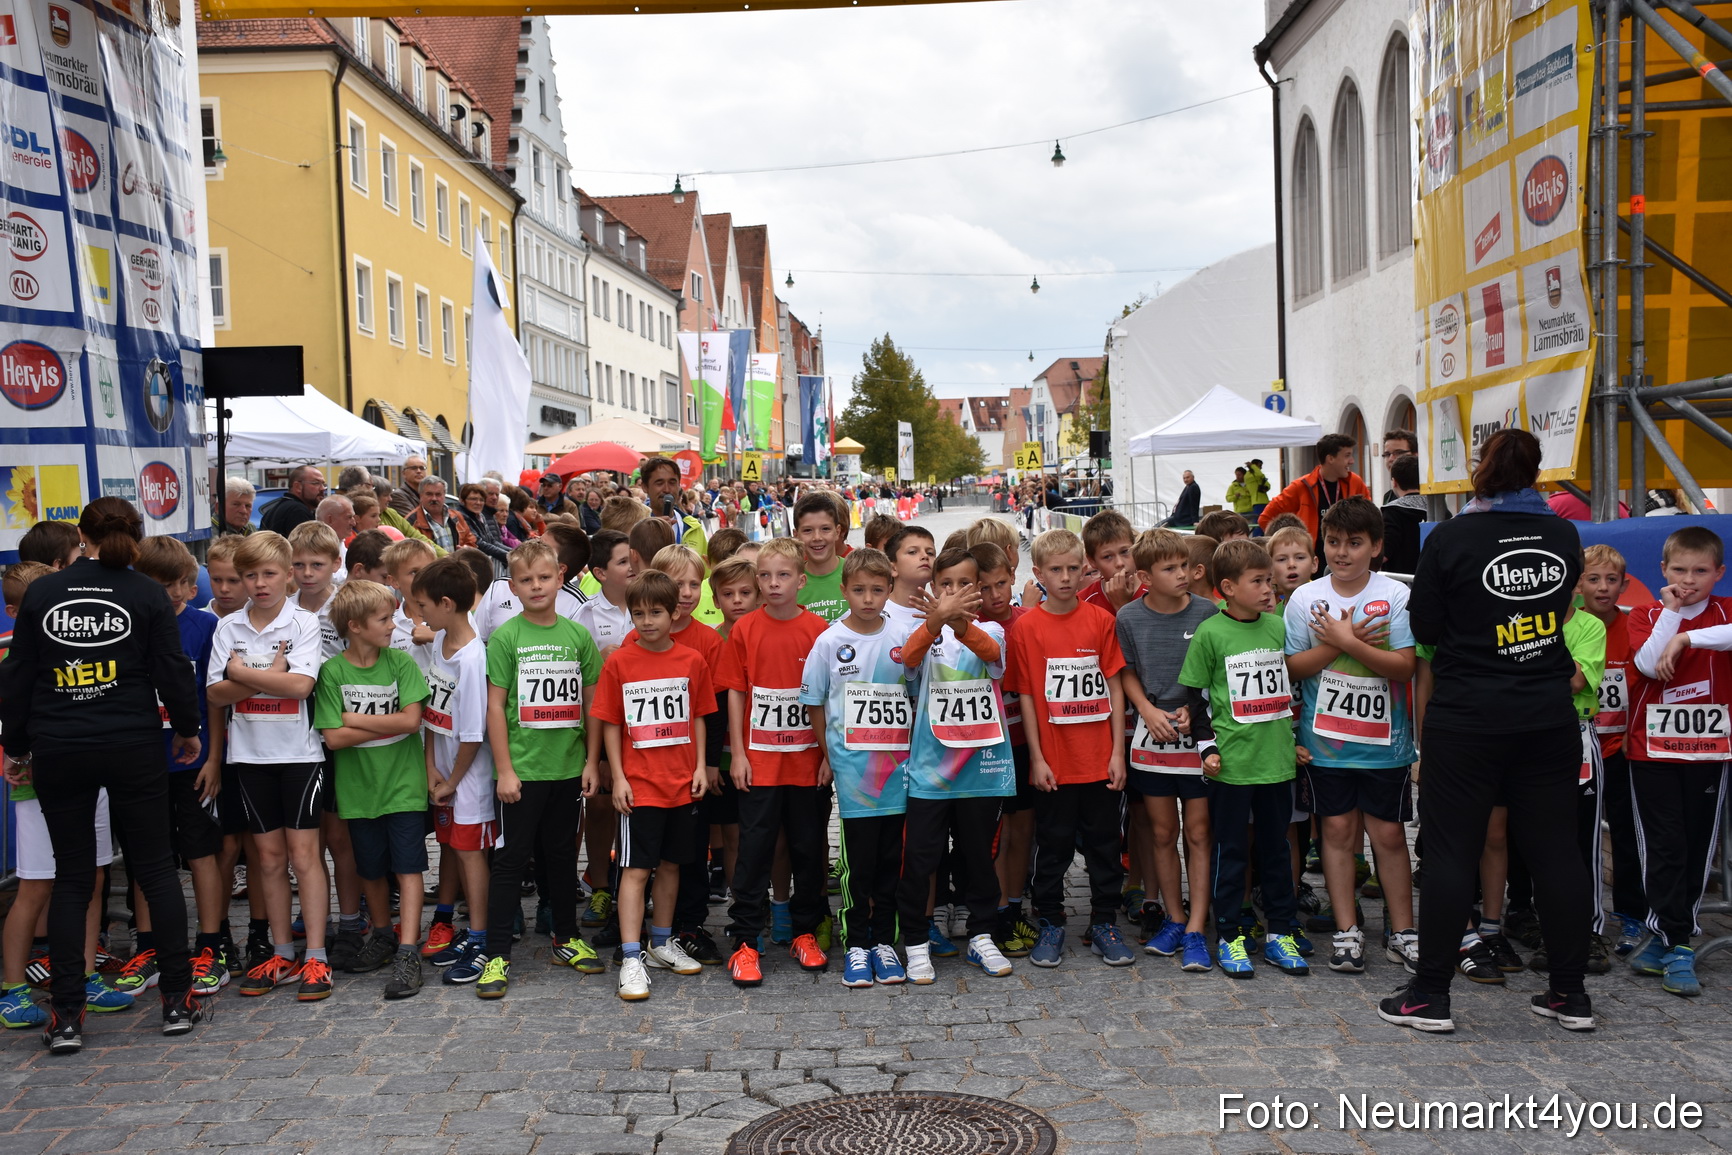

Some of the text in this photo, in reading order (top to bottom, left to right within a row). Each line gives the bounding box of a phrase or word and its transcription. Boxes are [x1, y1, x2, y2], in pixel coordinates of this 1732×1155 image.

[12, 151, 52, 168] energie
[1527, 170, 1564, 209] Hervis
[13, 236, 41, 251] JANIG
[13, 277, 34, 294] KIA
[1539, 312, 1575, 331] Neumarkter
[1486, 330, 1503, 352] Braun
[1534, 325, 1584, 352] Lammsbräu
[2, 355, 60, 393] Hervis
[1532, 406, 1577, 437] NATHUS
[1017, 456, 1024, 465] B
[1028, 450, 1039, 464] A
[746, 460, 757, 474] A
[142, 475, 177, 506] Hervis
[46, 506, 79, 521] KANN
[1492, 562, 1561, 587] Hervis
[1501, 584, 1531, 592] SPORTS
[1367, 603, 1388, 613] Hervis
[53, 610, 125, 636] Hervis
[1496, 611, 1557, 646] NEU
[517, 644, 562, 654] Neumarkter
[1509, 636, 1558, 654] NEUMARKT
[838, 665, 860, 673] PARTL
[1255, 659, 1280, 667] Neumarkt
[53, 660, 117, 687] NEU
[526, 677, 579, 703] 7049
[625, 685, 680, 696] PARTL Neumarkt
[1052, 671, 1105, 698] 7169
[1236, 669, 1283, 697] 7137
[1322, 677, 1380, 691] PARTL Neumarkt
[754, 693, 774, 701] PARTL
[1675, 687, 1697, 697] DEHN
[246, 702, 281, 712] Vincent
[632, 694, 684, 722] 7161
[853, 700, 908, 725] 7555
[937, 696, 993, 722] 7413
[1062, 703, 1100, 715] Walfried
[1326, 688, 1385, 720] 7409
[534, 708, 574, 720] Benjamin
[1656, 708, 1723, 734] 7002
[655, 726, 673, 737] Fati
[776, 733, 794, 743] Tim
[981, 749, 996, 758] 16.
[1663, 739, 1716, 753] Sebastian
